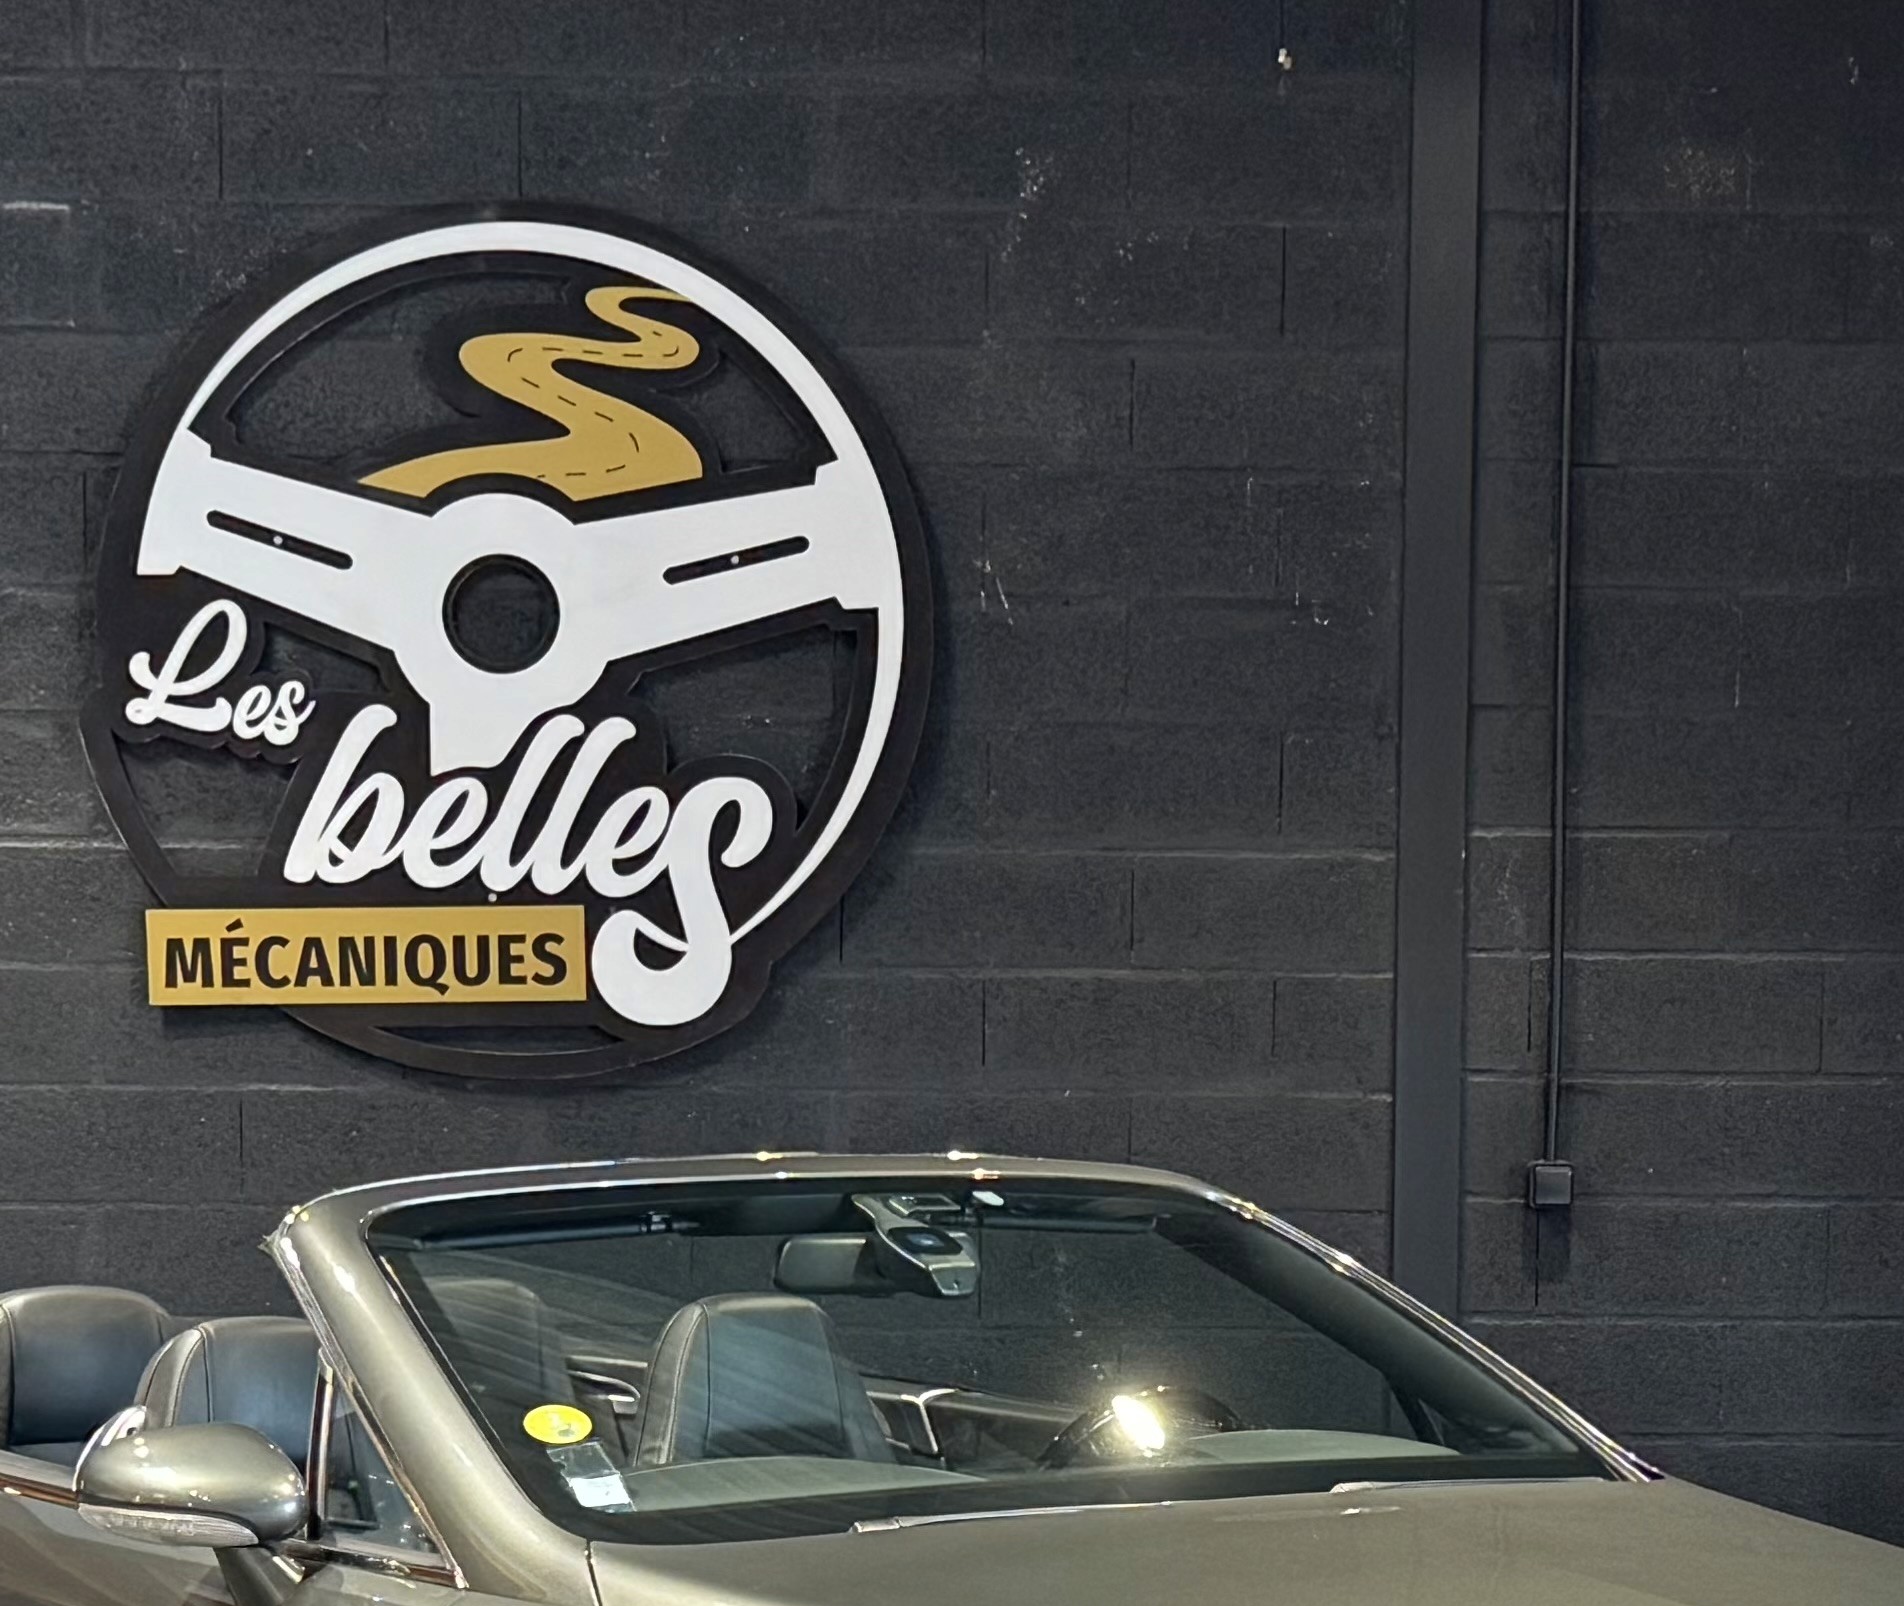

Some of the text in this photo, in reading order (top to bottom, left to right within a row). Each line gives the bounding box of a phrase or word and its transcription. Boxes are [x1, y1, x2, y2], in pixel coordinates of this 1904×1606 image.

[126, 598, 317, 745] Les
[284, 703, 773, 1026] belles
[165, 919, 568, 995] MÉCANIQUES
